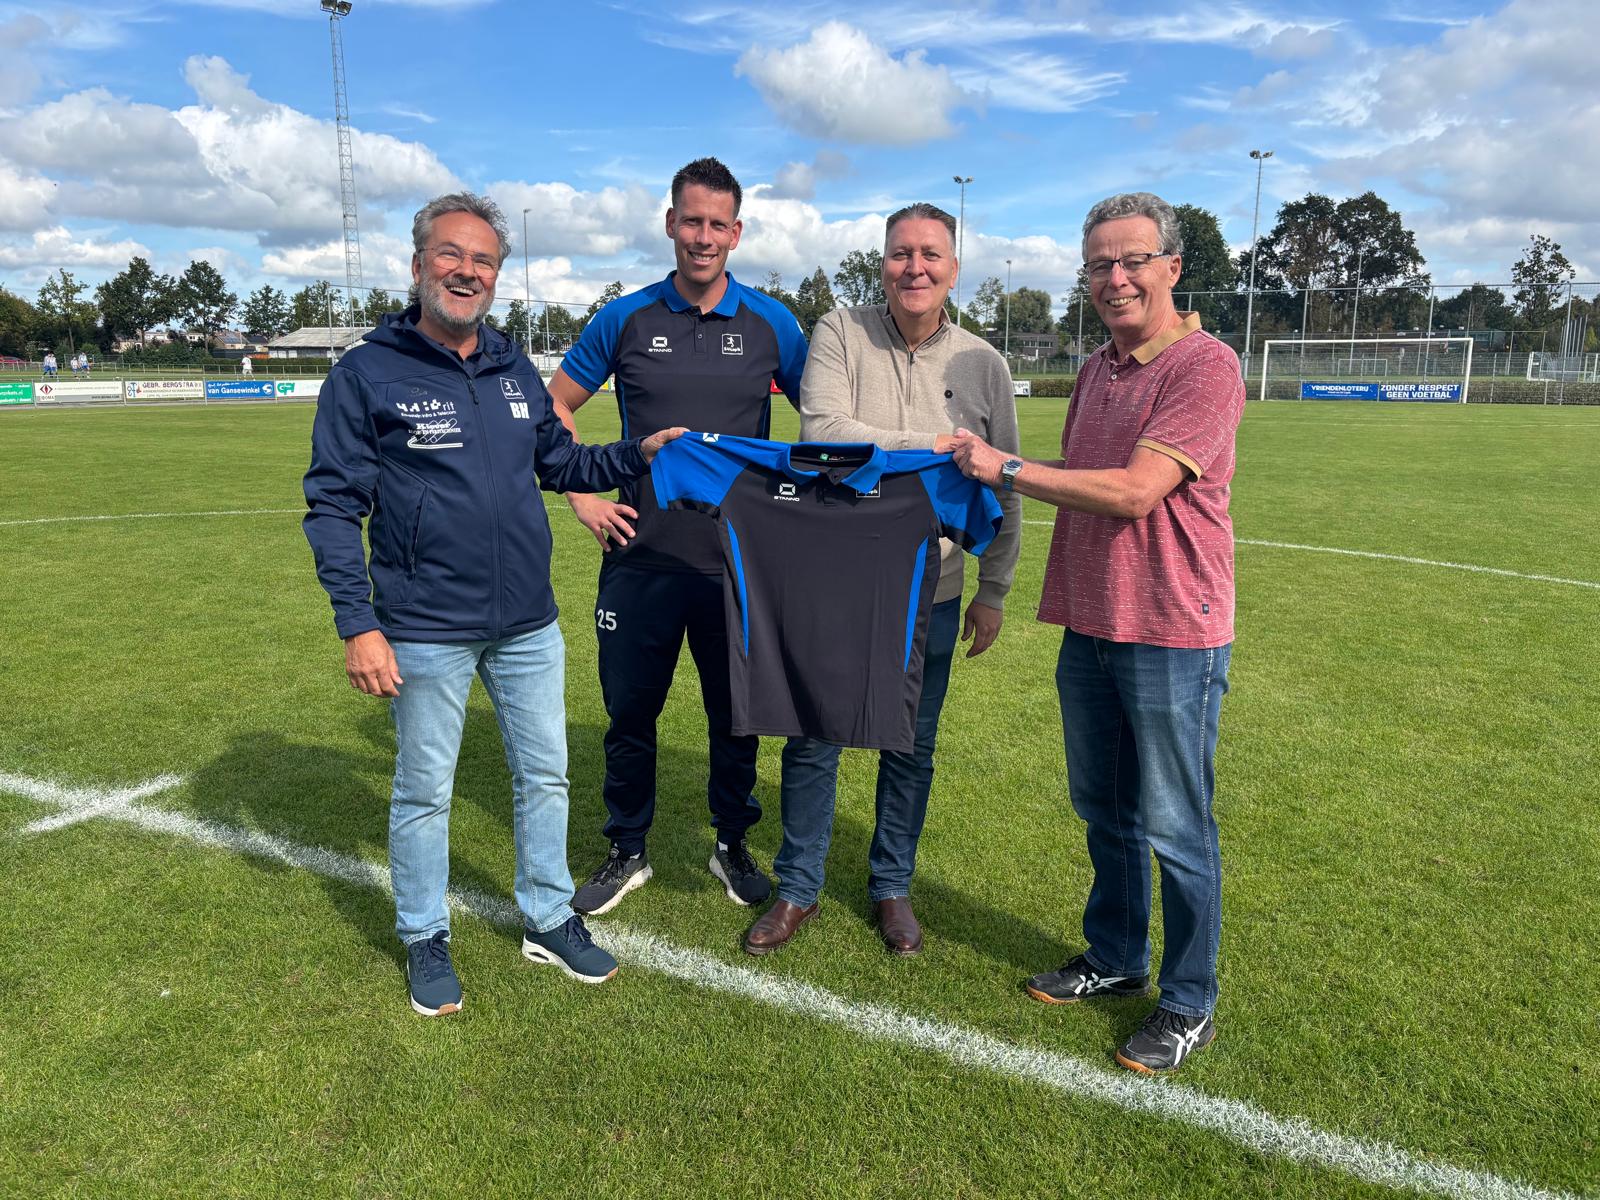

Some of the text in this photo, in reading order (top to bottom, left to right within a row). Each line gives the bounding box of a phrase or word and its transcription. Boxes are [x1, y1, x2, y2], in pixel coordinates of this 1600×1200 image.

[221, 386, 260, 394] Gansewinkel
[510, 402, 530, 419] BH
[598, 608, 617, 631] 25
